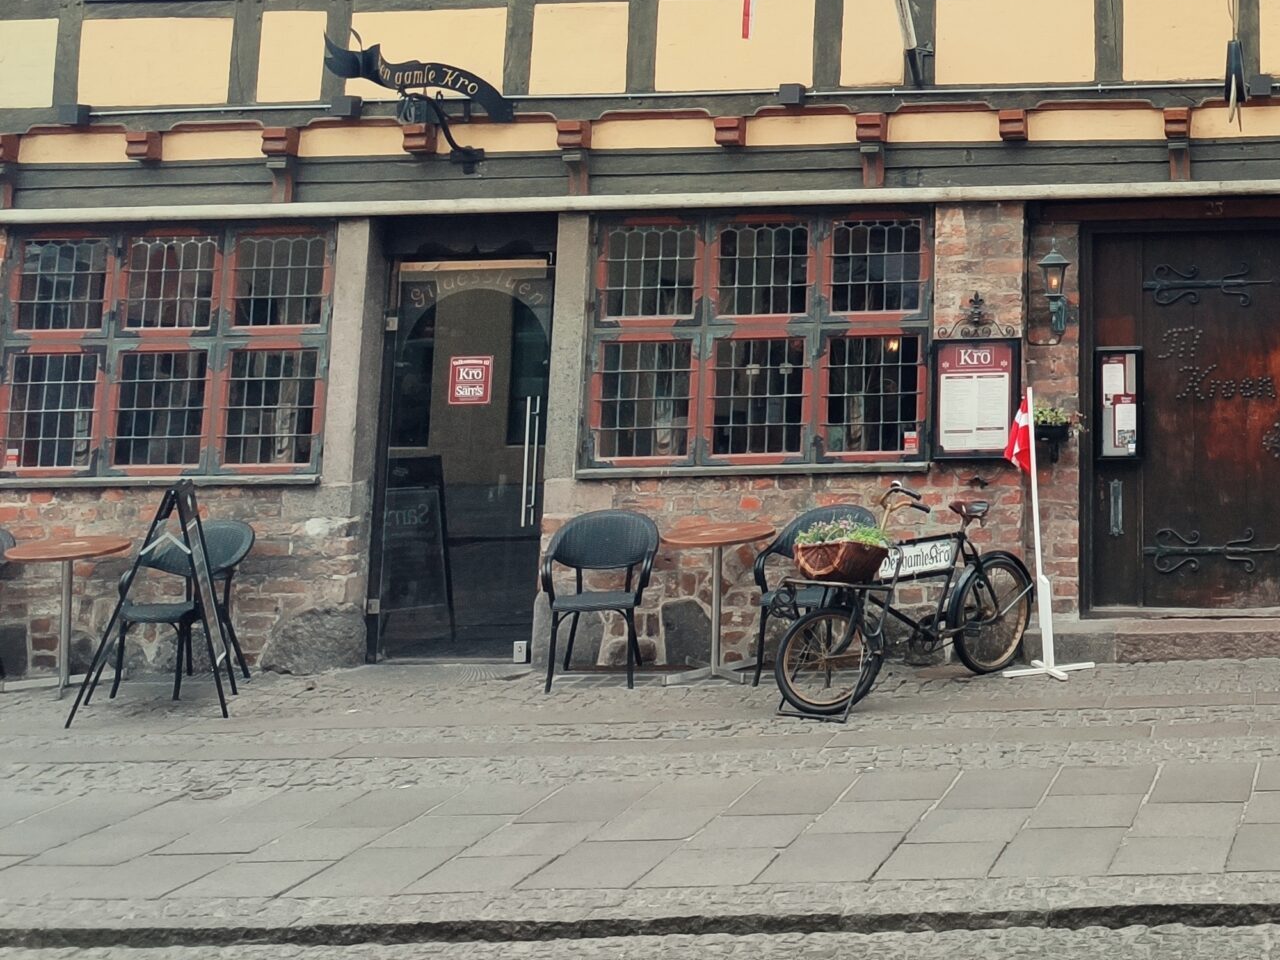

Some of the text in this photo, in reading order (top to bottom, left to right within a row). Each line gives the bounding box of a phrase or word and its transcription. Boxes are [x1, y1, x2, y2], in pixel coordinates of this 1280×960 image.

[438, 67, 479, 95] Kro
[959, 348, 992, 366] Kro
[459, 367, 483, 380] Kro
[1175, 363, 1277, 400] Kroen
